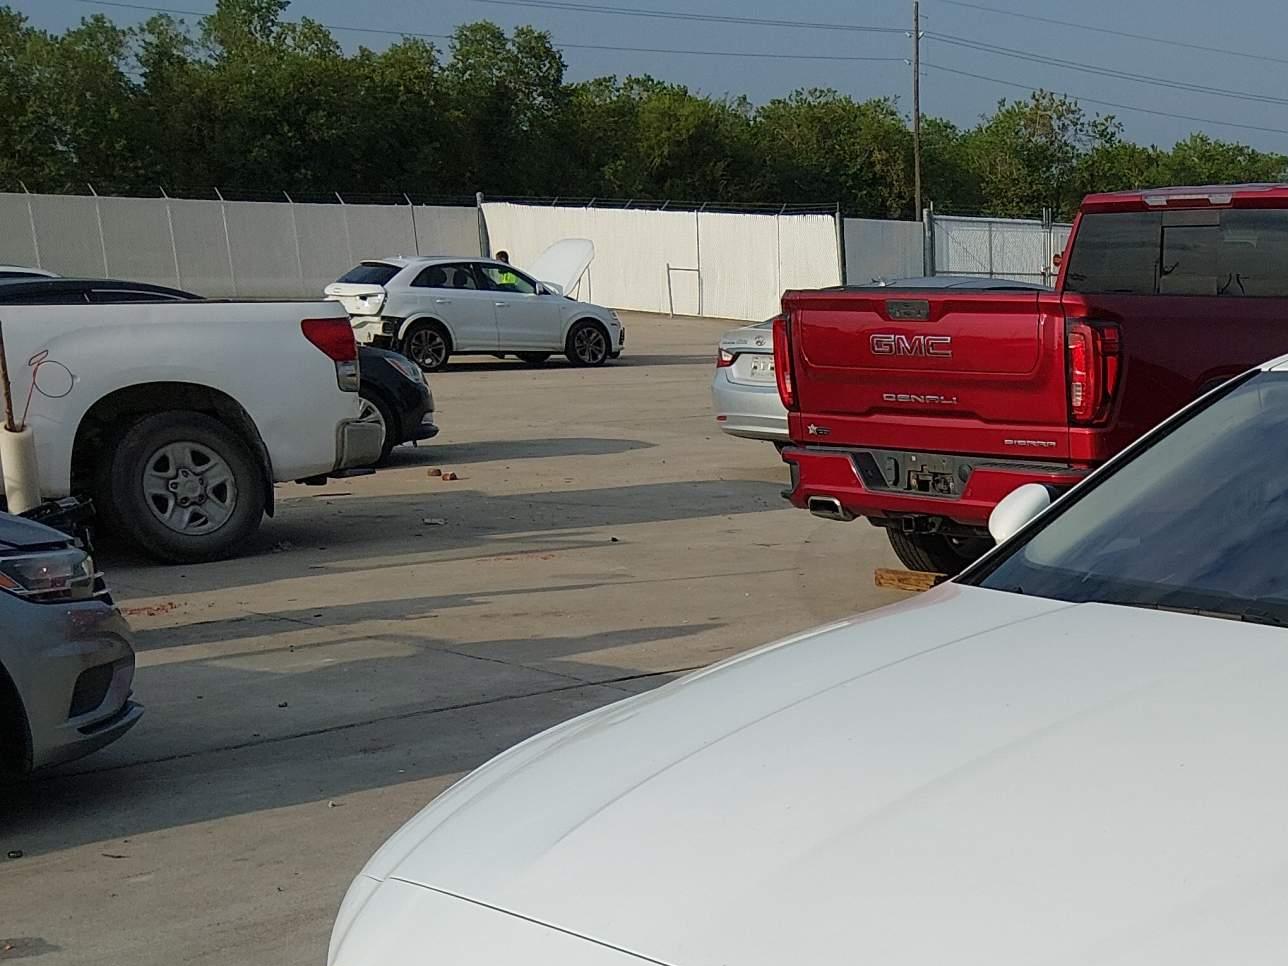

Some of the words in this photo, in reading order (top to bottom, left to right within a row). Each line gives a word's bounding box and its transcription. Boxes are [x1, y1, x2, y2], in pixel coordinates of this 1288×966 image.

[869, 334, 953, 358] GMC
[882, 393, 958, 405] DENALI
[1003, 438, 1057, 448] SIERRA
